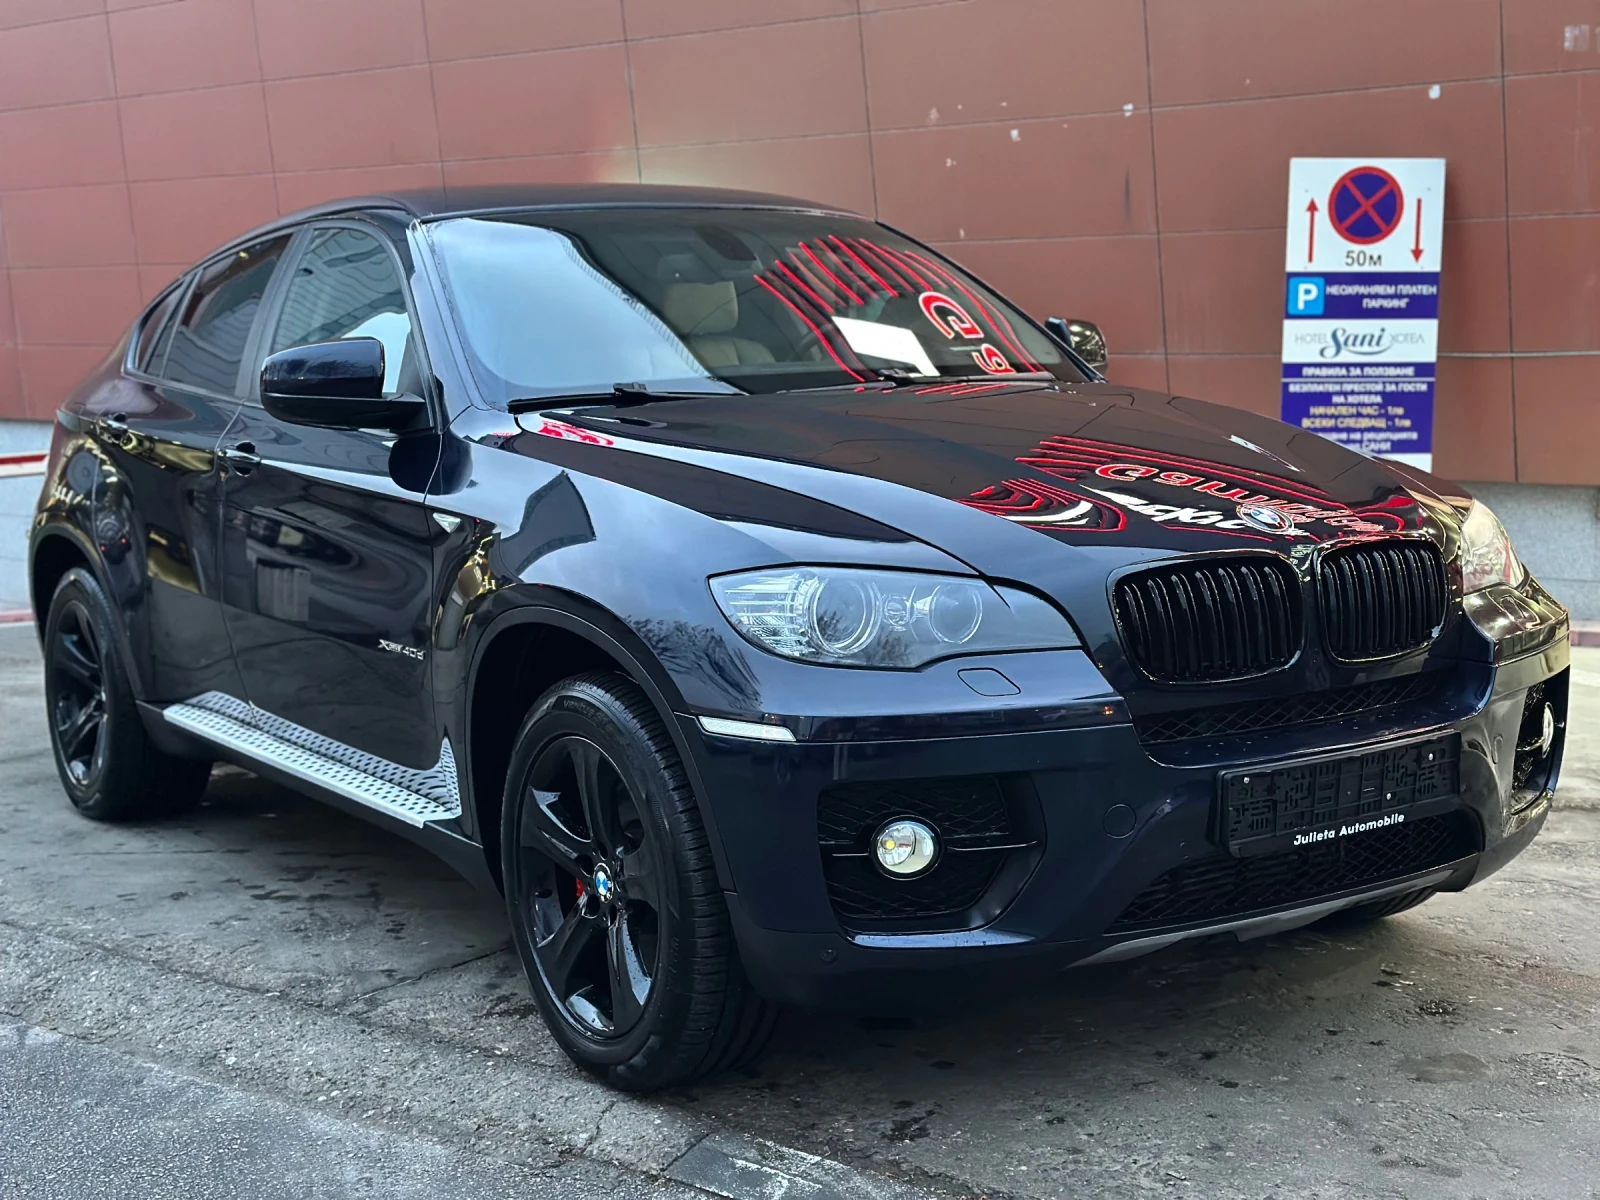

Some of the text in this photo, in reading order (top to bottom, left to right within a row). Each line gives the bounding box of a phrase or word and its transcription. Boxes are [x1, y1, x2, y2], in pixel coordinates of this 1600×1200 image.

[1397, 284, 1437, 296] ПЛАТЕН
[1297, 283, 1318, 310] P
[1362, 297, 1410, 309] ПАРКИНГ
[1295, 327, 1392, 359] HOTEL Sani
[1348, 366, 1362, 377] ЗА
[1385, 382, 1397, 392] ЗА
[1398, 382, 1428, 392] ГОСТИ
[1293, 813, 1405, 846] Julieta Automobile
